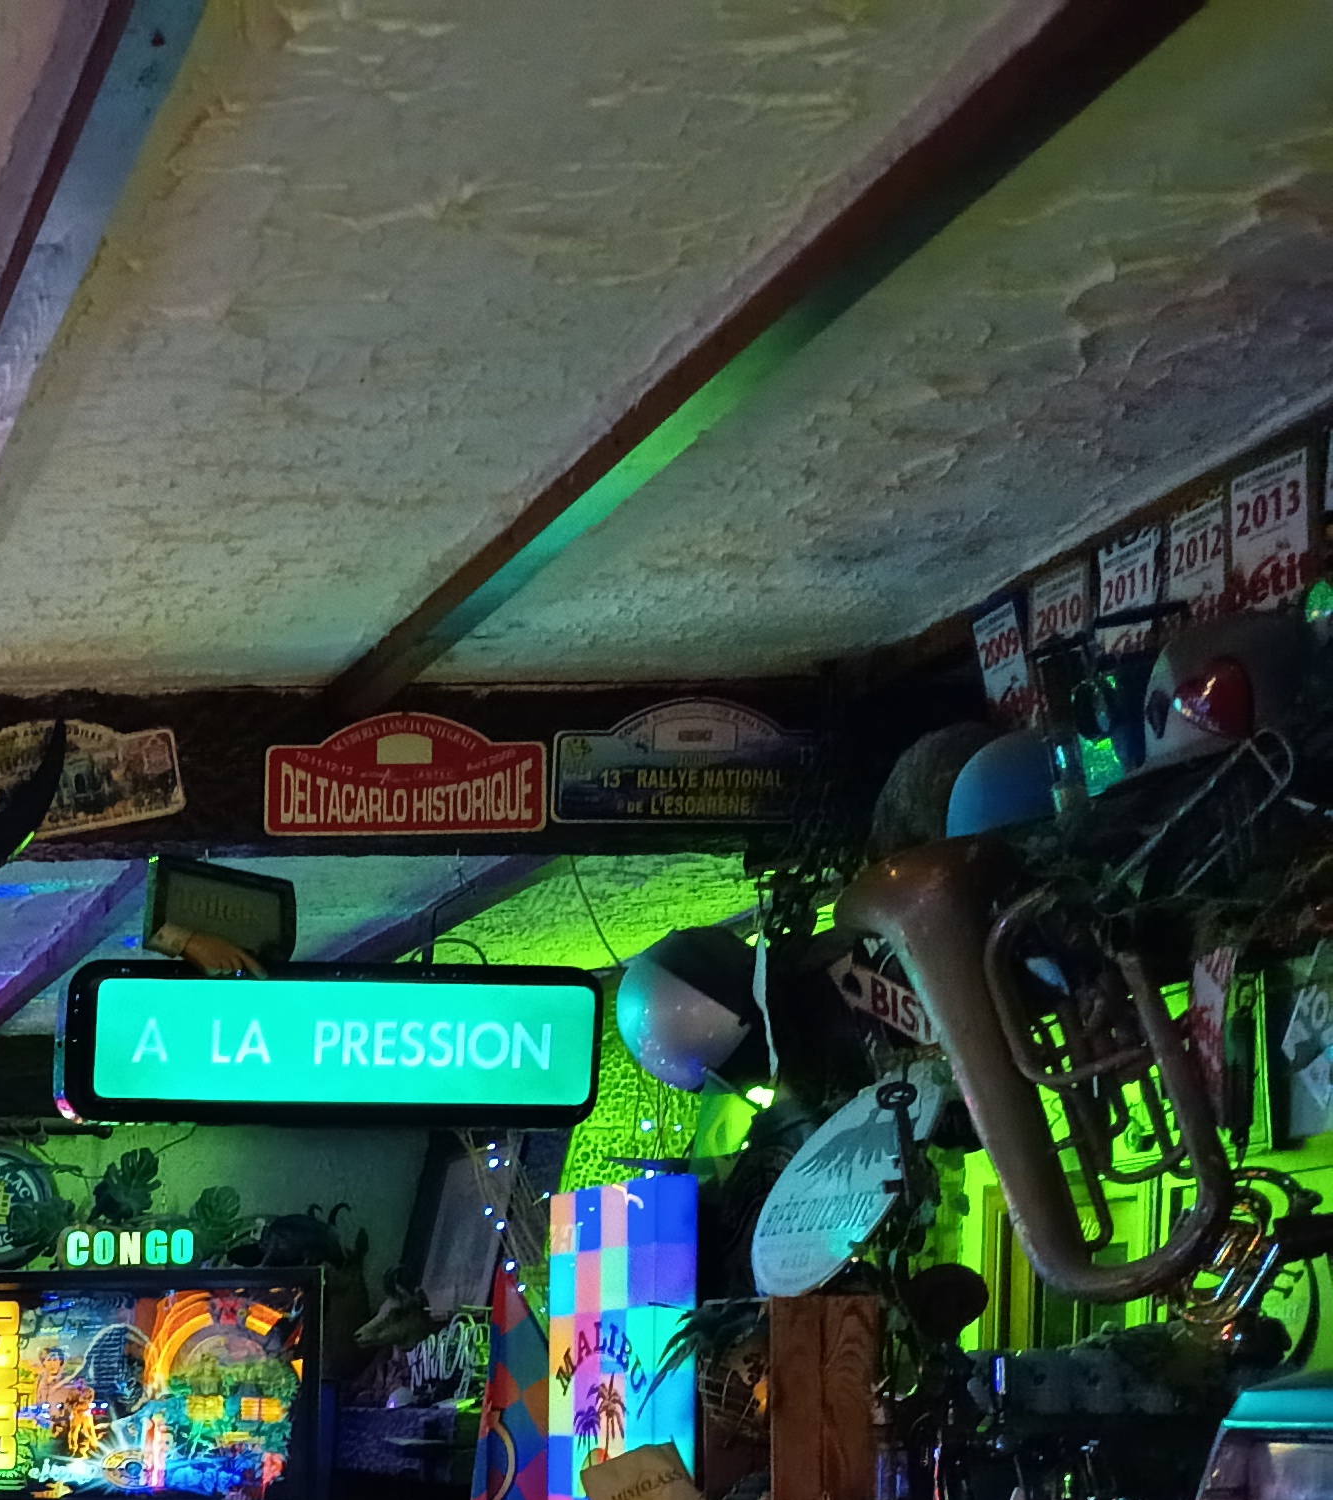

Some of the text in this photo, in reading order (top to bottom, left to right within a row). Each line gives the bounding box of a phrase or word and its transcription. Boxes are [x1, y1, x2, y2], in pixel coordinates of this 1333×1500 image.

[1235, 479, 1301, 539] 2013
[1173, 522, 1223, 578] 2012
[1103, 562, 1150, 613] 2011
[1035, 593, 1081, 639] 2010
[382, 720, 422, 734] LANCIA
[280, 756, 534, 824] DELTACARLO HISTORIQUE
[636, 769, 699, 789] RALLYE
[132, 1017, 553, 1072] A LA PRESSION
[66, 1228, 195, 1267] CONGO
[556, 1321, 648, 1397] MALIBU
